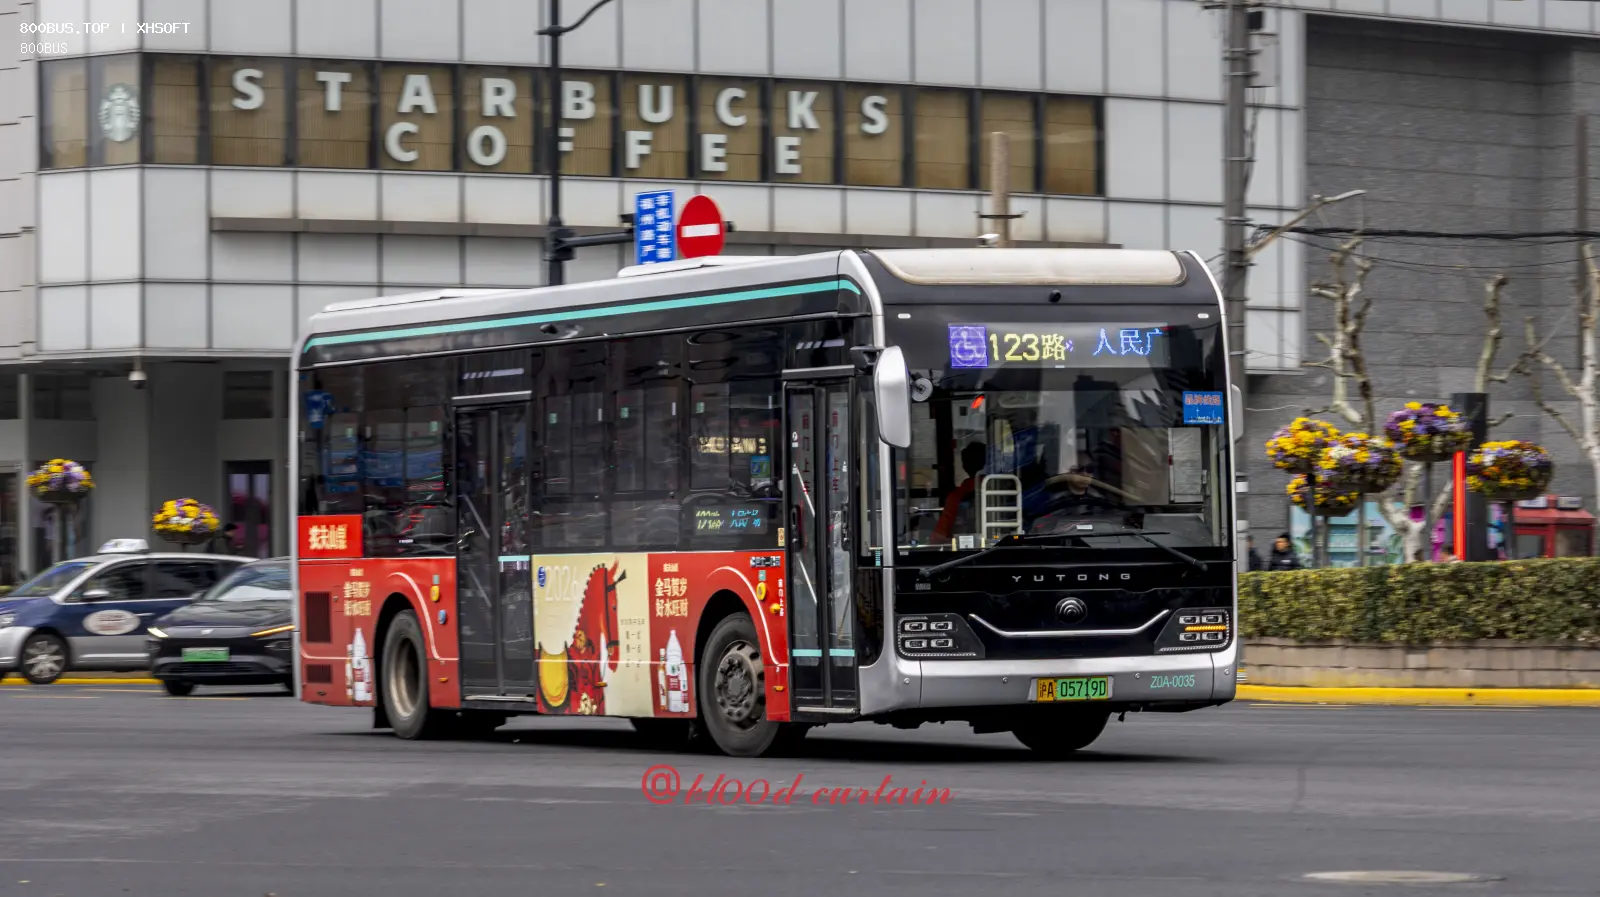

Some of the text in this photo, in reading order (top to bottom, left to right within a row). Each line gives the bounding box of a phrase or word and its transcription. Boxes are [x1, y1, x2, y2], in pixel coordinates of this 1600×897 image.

[230, 67, 889, 135] STARBUCKS
[990, 332, 1066, 361] 123路
[654, 577, 688, 597] 金马贺岁
[1011, 573, 1132, 583] YUTONG
[655, 598, 689, 618] 好水旺财
[1060, 680, 1107, 697] 05719D
